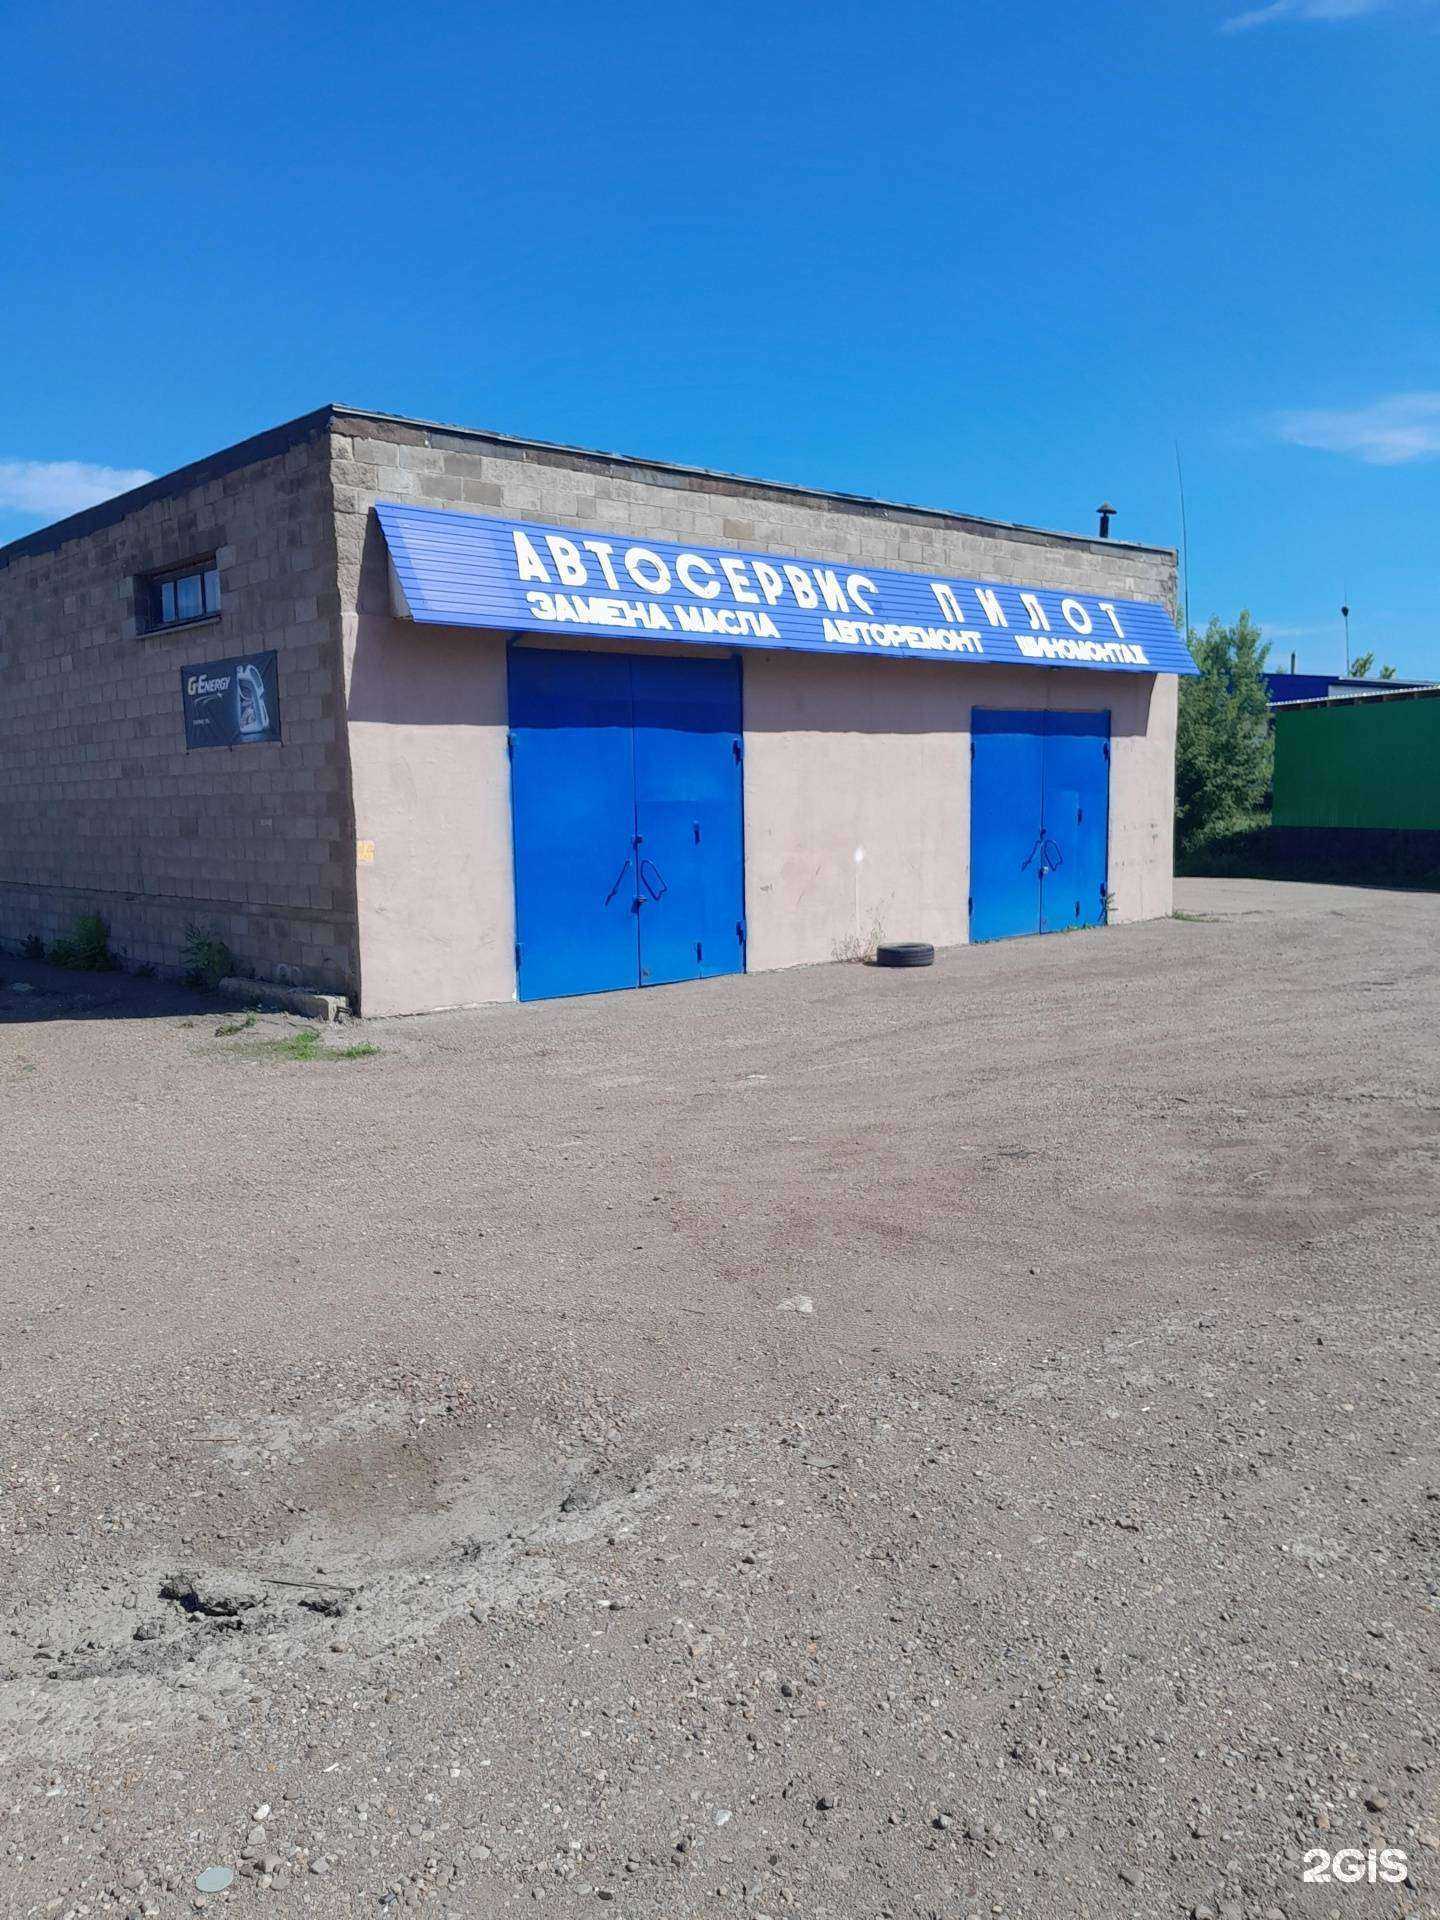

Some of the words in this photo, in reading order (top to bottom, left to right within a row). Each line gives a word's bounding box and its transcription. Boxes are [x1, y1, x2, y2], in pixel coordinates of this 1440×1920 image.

[512, 530, 879, 616] АВТОСЕРВИС
[930, 583, 1124, 639] ПИЛОТ
[525, 591, 673, 630] ЗАМЕНА
[673, 605, 781, 638] МАСЛА
[823, 618, 984, 653] АВТОРЕМОНТ
[1014, 635, 1150, 665] ШИНОМОНТАЖ
